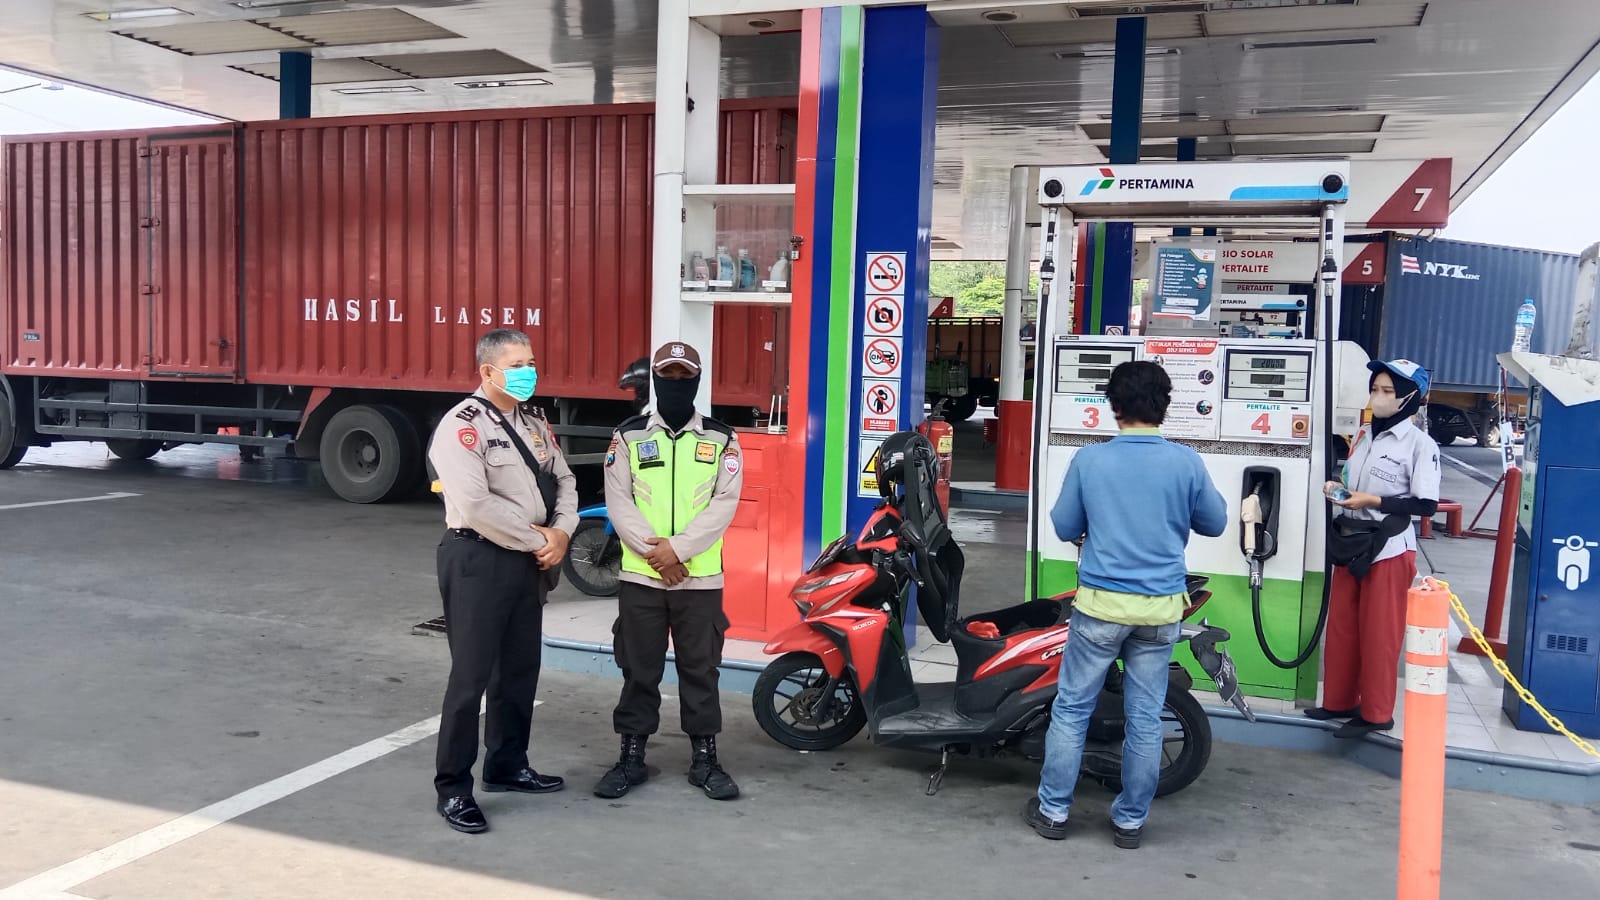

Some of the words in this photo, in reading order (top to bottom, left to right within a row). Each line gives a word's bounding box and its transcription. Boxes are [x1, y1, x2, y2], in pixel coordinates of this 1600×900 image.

[1119, 179, 1194, 190] PERTAMINA
[1413, 187, 1433, 212] 7
[1240, 250, 1274, 258] SOLAR
[1221, 264, 1270, 273] ERTALITE
[1361, 259, 1373, 276] 5
[1423, 261, 1469, 280] NYK
[1236, 284, 1275, 292] PERTALITE
[304, 298, 403, 323] HASIL
[434, 306, 542, 326] LASEM
[942, 305, 948, 314] 2
[1074, 396, 1107, 404] PERTALITE
[1246, 403, 1281, 411] PERTALITE
[1082, 406, 1100, 428] 3
[1250, 412, 1271, 435] 4
[852, 619, 878, 631] HONDA
